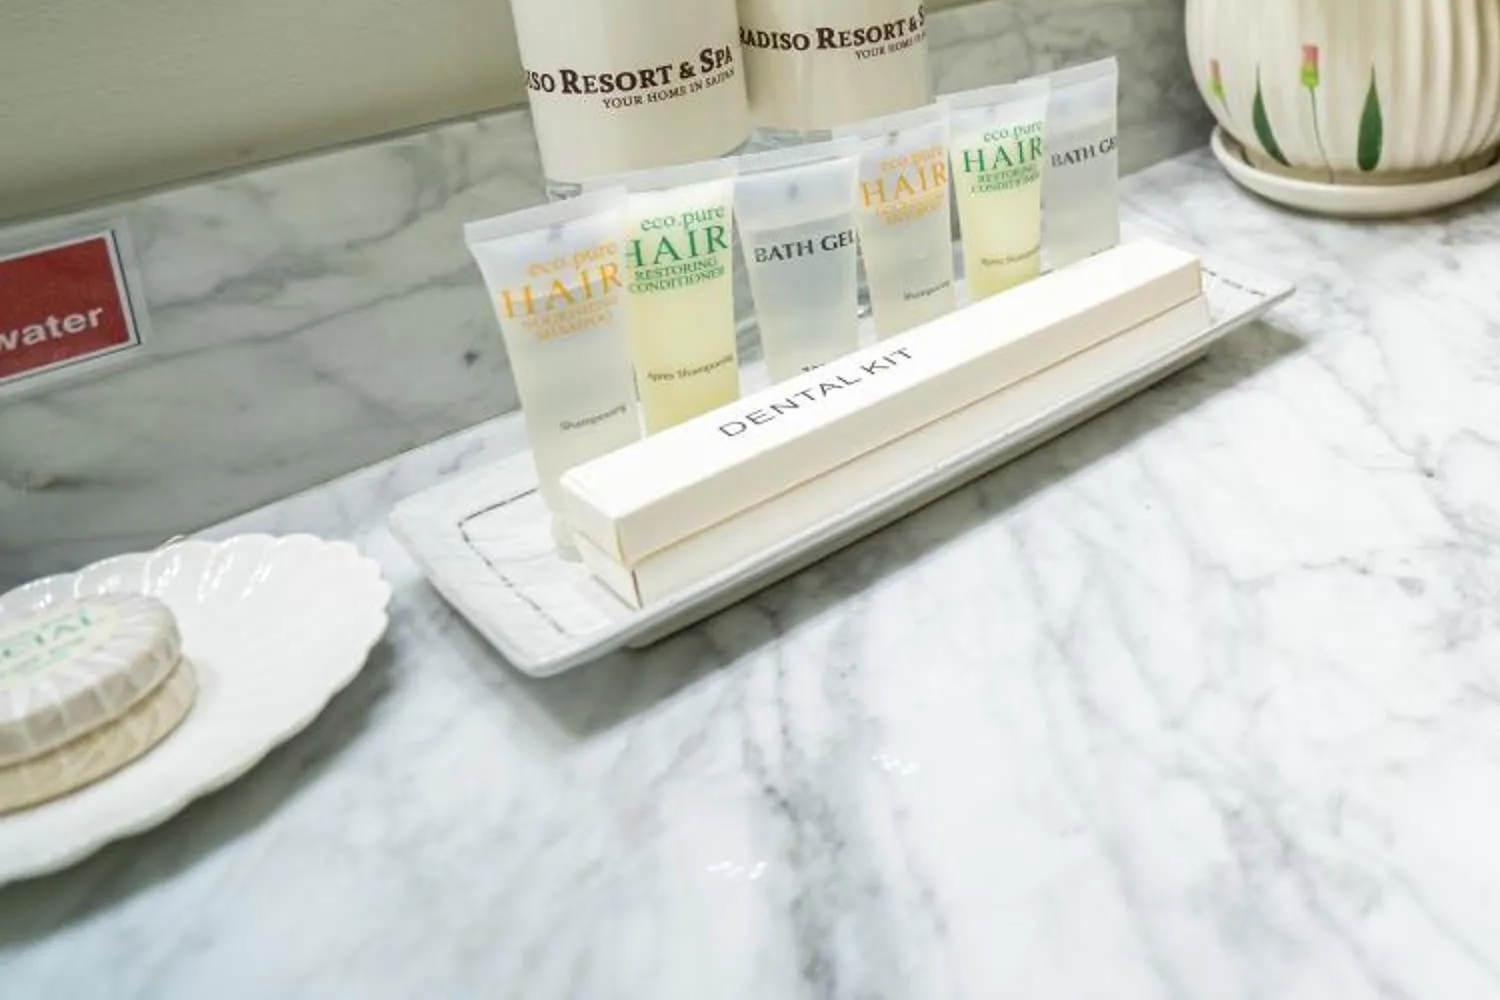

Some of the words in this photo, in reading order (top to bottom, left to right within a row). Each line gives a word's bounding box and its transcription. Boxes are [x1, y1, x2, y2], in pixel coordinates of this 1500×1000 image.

[679, 61, 696, 80] &
[602, 95, 644, 109] YOUR
[647, 85, 687, 104] HOME
[689, 79, 704, 94] IN
[963, 136, 1043, 173] HAIR
[1050, 144, 1096, 168] BATH
[862, 161, 946, 207] HAIR
[752, 239, 815, 263] BATH
[500, 262, 623, 320] HAIR
[718, 374, 863, 438] DENTAL
[860, 347, 913, 376] KIT
